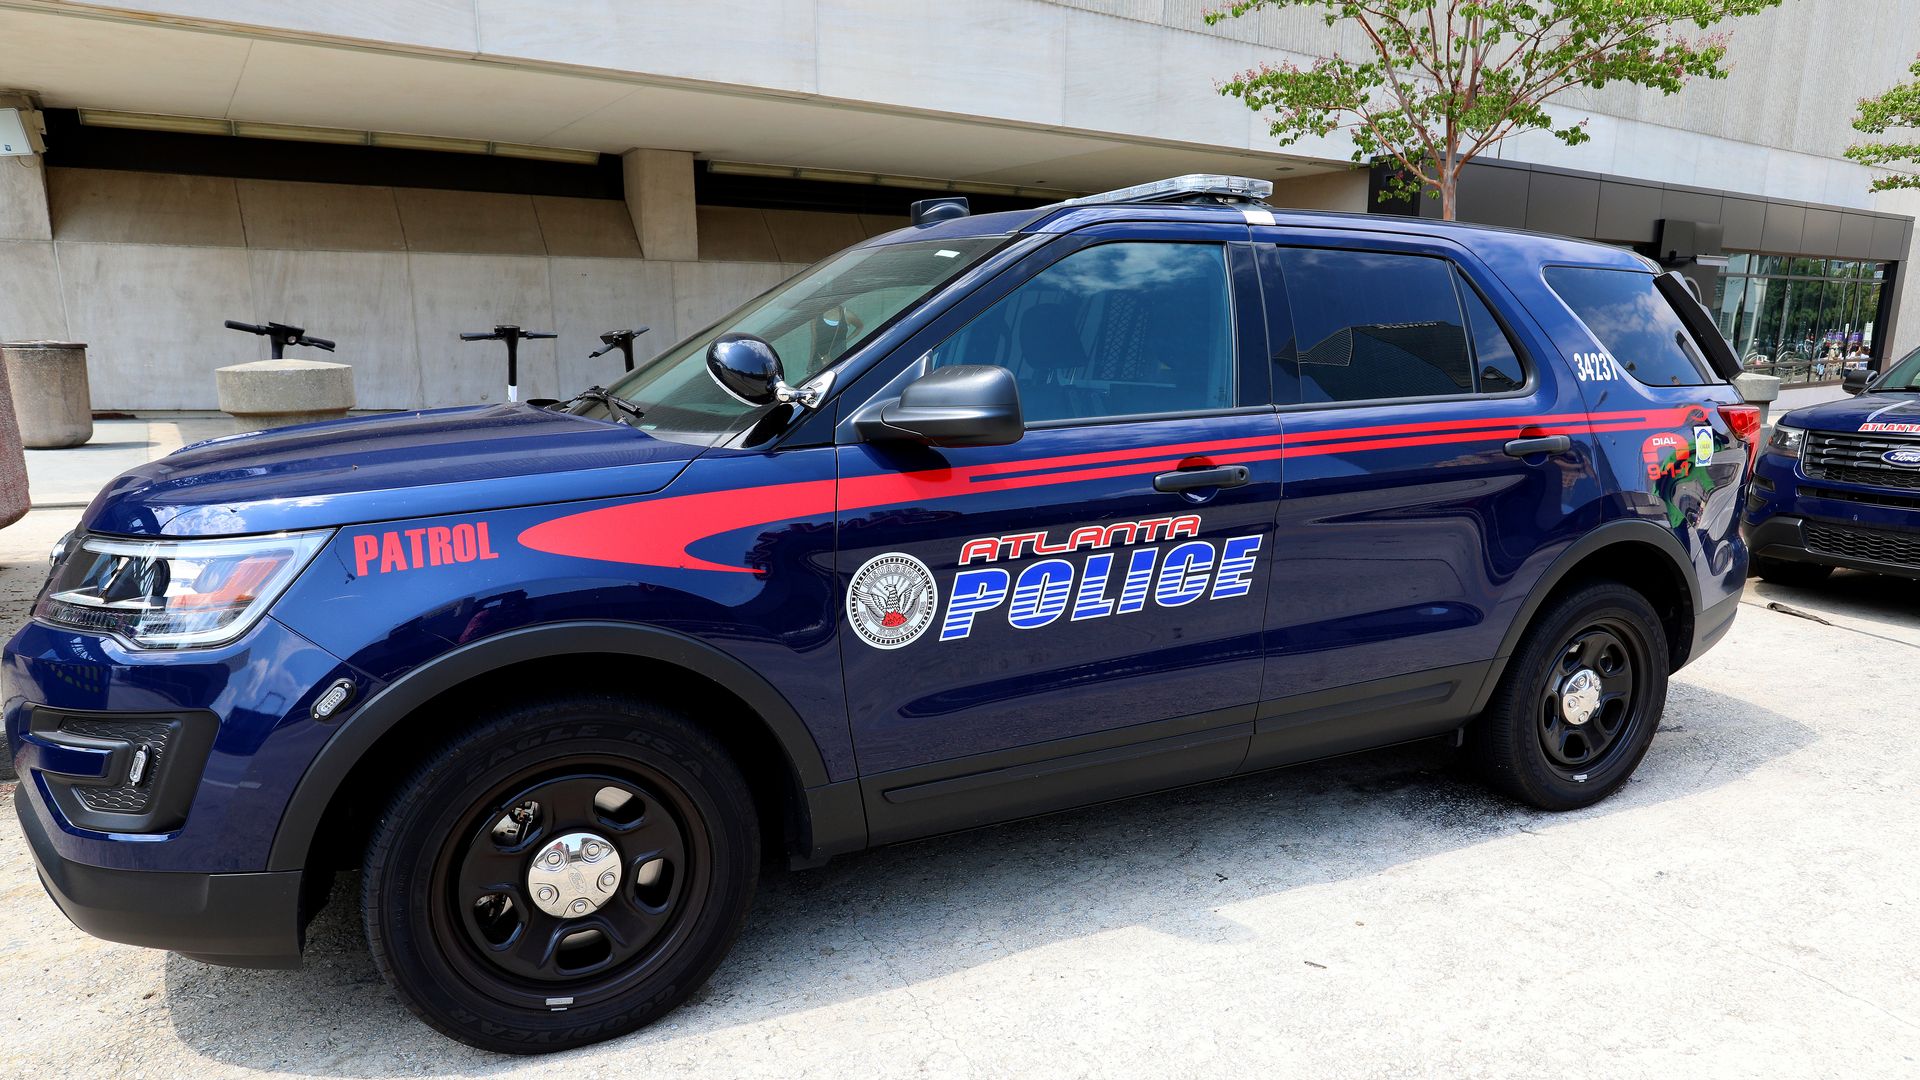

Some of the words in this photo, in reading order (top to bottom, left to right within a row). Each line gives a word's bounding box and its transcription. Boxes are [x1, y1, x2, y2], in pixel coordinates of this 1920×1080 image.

[1652, 437, 1677, 446] DIAL
[1647, 461, 1690, 481] 9-1-1
[353, 521, 499, 577] PATROL
[958, 514, 1202, 566] ATLANTA
[939, 534, 1264, 642] POLICE
